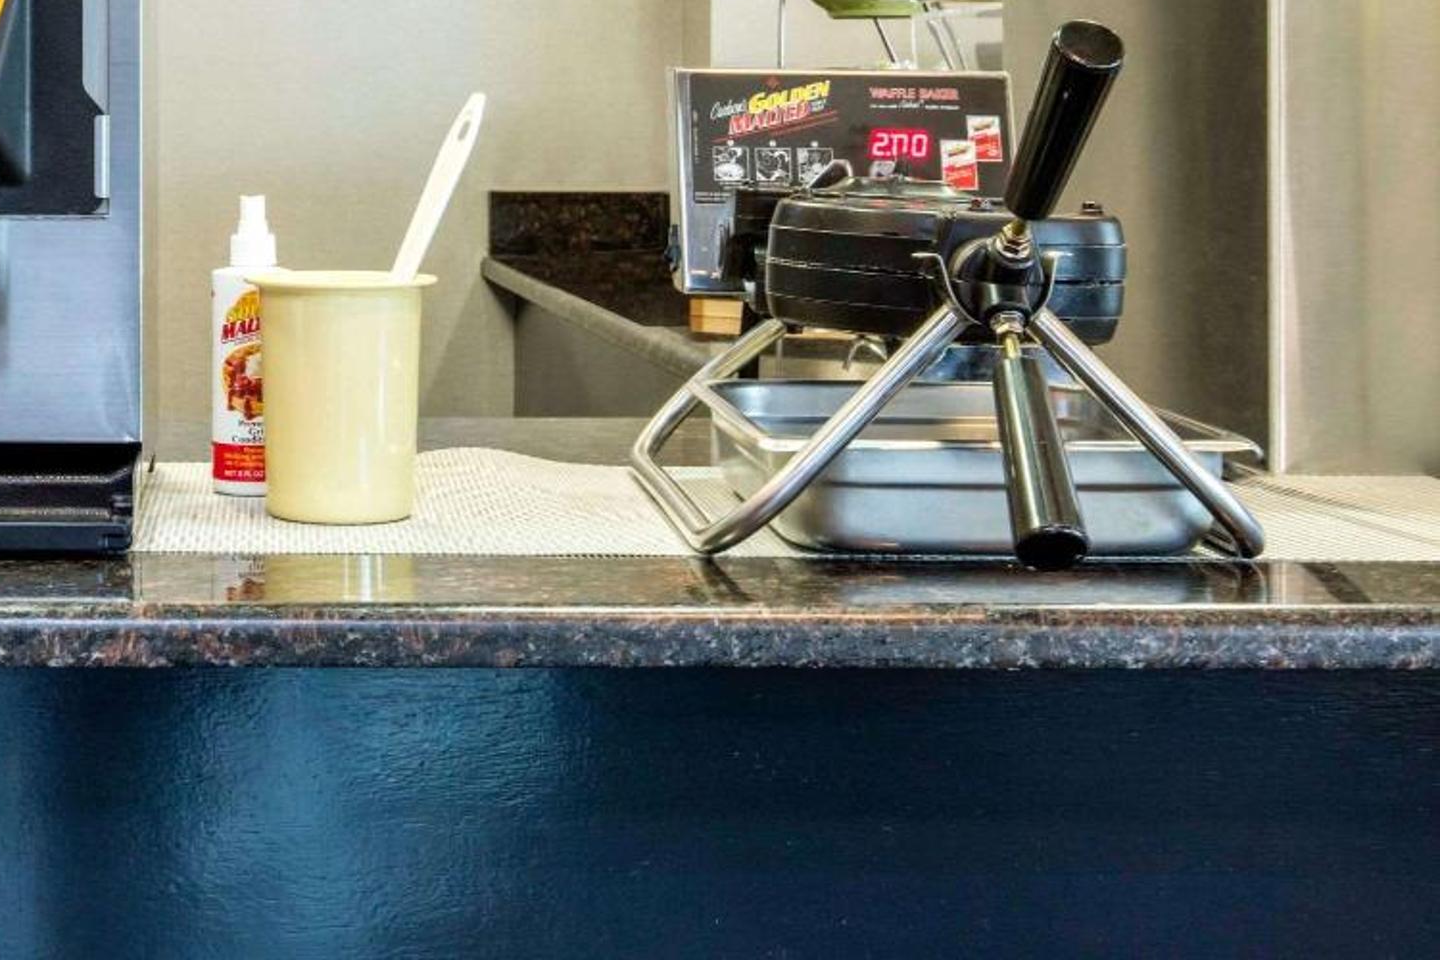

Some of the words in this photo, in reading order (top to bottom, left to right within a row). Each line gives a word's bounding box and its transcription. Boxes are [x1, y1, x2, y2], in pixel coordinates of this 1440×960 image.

[748, 80, 831, 114] GOLDEN
[869, 87, 916, 100] WAFFLE
[919, 87, 959, 101] BAKER
[728, 100, 810, 136] MALTED
